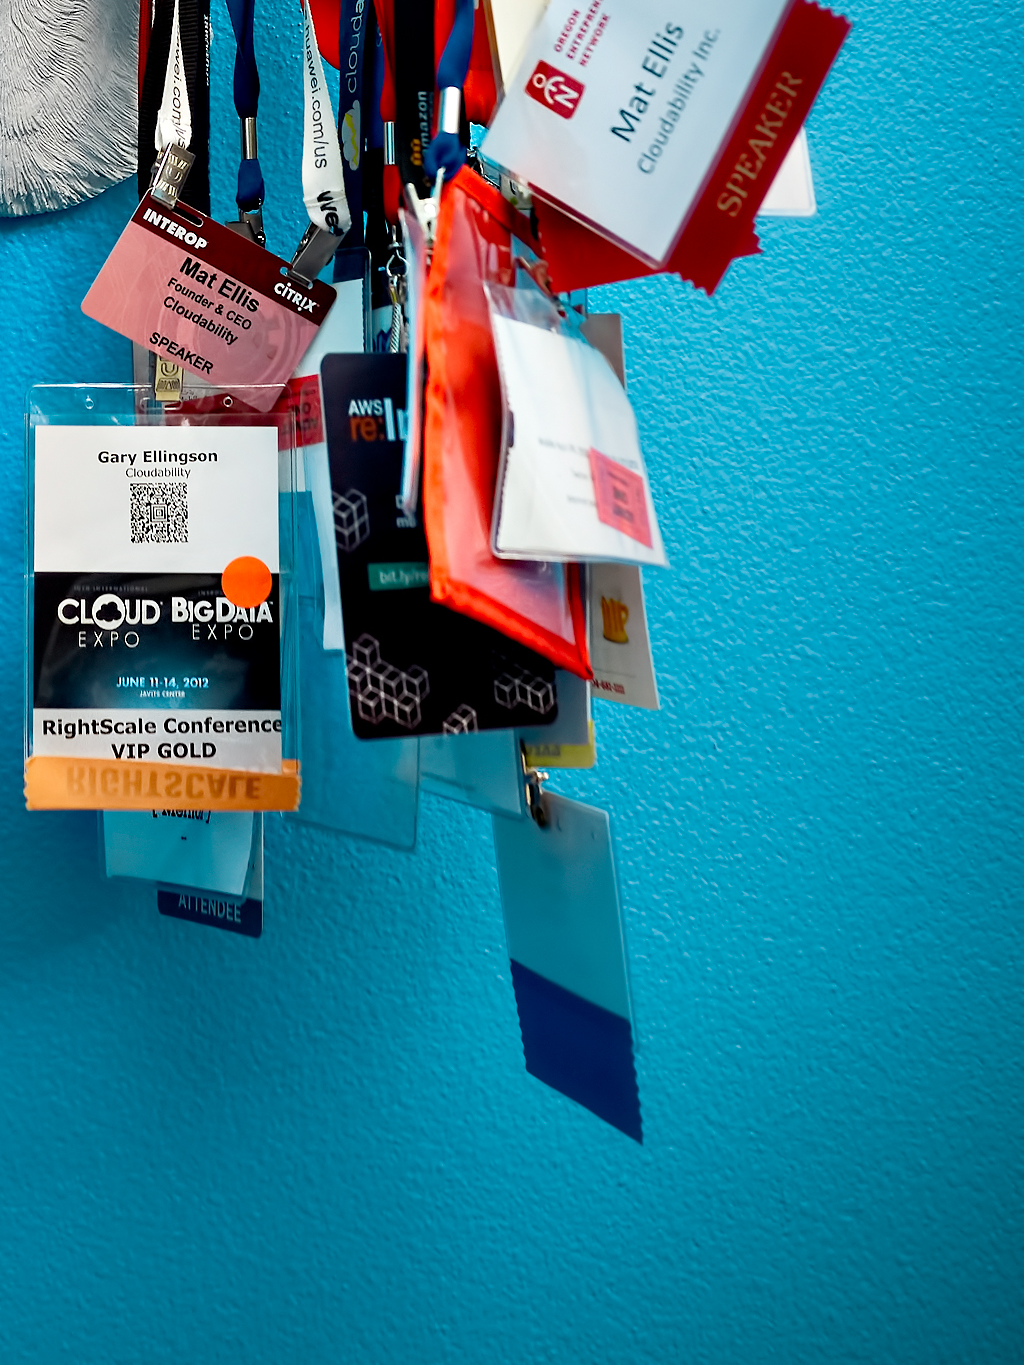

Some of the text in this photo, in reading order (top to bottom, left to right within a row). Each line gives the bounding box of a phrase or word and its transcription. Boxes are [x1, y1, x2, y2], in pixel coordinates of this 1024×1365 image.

[554, 9, 580, 53] OREGON
[579, 13, 611, 67] NETWORK
[610, 22, 685, 143] Mat Ellis
[637, 28, 721, 174] Cloudability Inc.
[418, 91, 428, 151] mazon
[717, 70, 804, 218] SPEAKER
[143, 208, 209, 250] INTEROP
[167, 277, 252, 331] Founder & CEO
[179, 257, 260, 313] Mat Ellis
[163, 296, 238, 345] Cloudability
[149, 332, 214, 375] SPEAKER
[348, 399, 384, 416] AWS
[98, 450, 218, 466] Gary Ellingson
[125, 467, 191, 478] Cloudability
[57, 593, 161, 630] CLOUD
[78, 623, 254, 648] EXPO EXPO
[116, 676, 209, 689] JUNE 11-14, 2012
[42, 717, 282, 739] RightScale Conference
[111, 742, 217, 759] VIP GOLD
[178, 894, 242, 923] ATTENDEE
